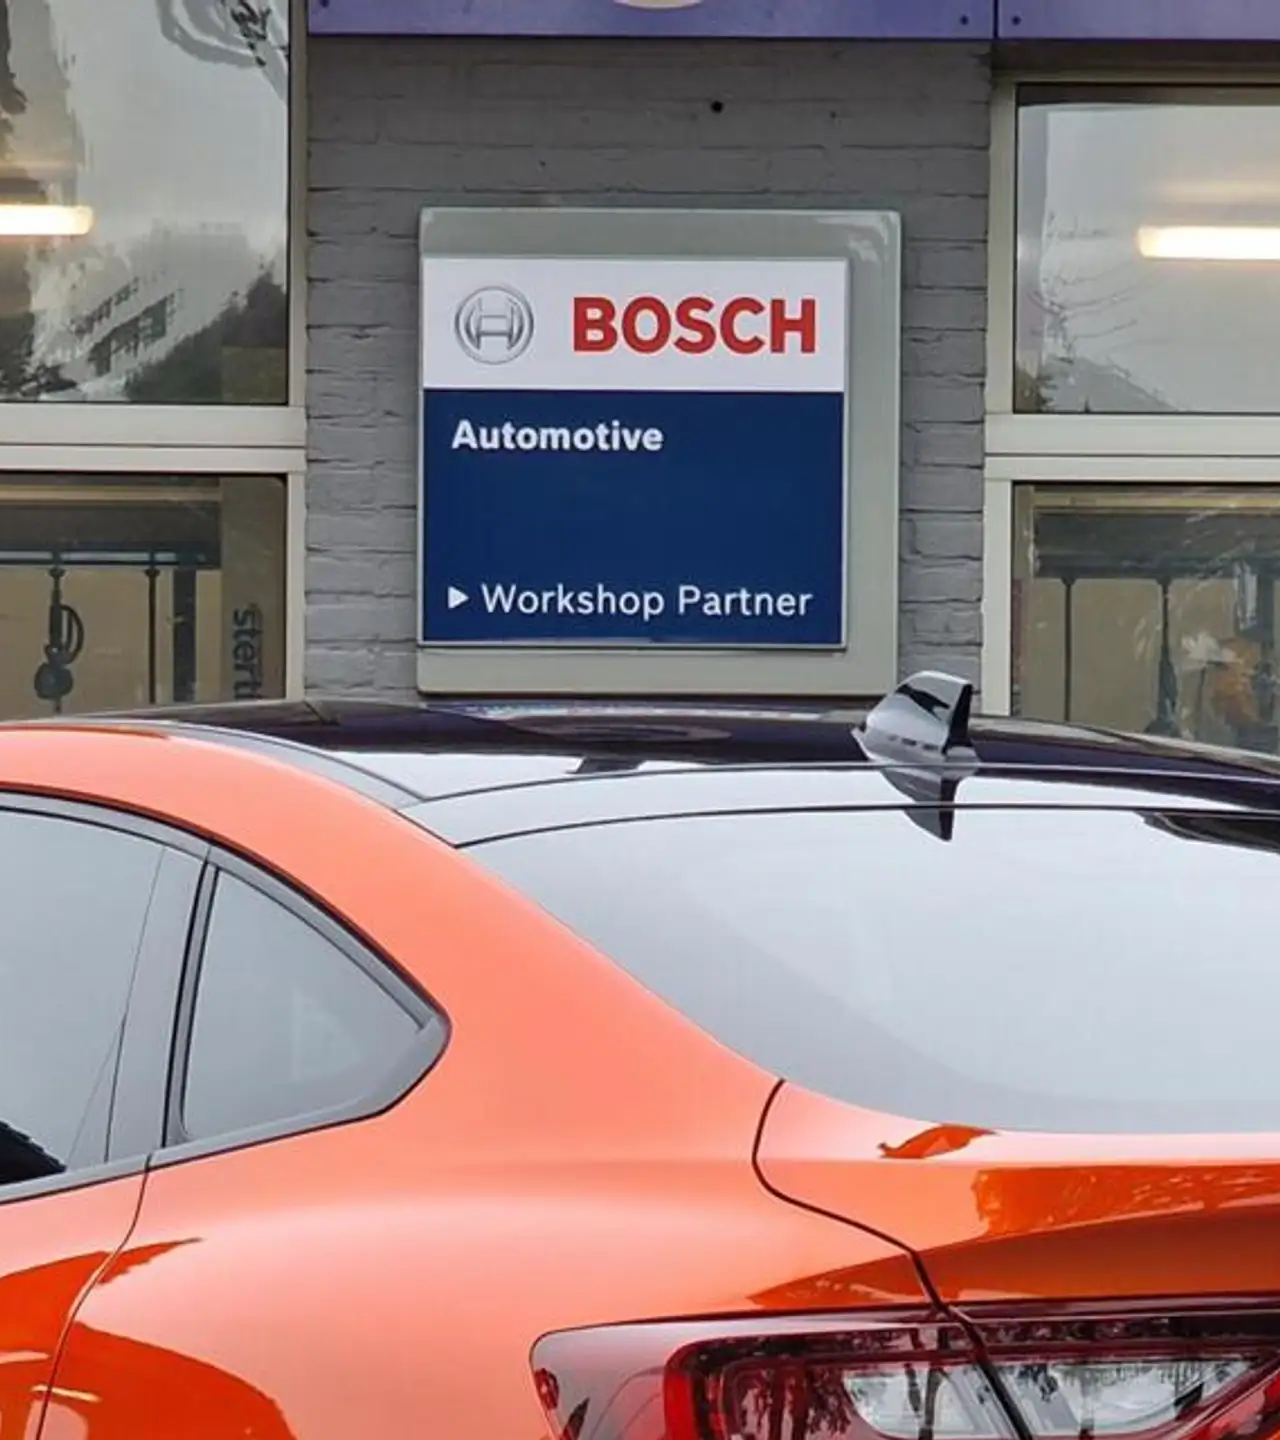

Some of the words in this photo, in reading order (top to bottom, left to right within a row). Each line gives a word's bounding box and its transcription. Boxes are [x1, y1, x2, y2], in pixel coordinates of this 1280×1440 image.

[573, 295, 816, 354] BOSCH
[451, 419, 664, 452] Automotive
[480, 583, 665, 621] Workshop
[678, 584, 813, 616] Partner
